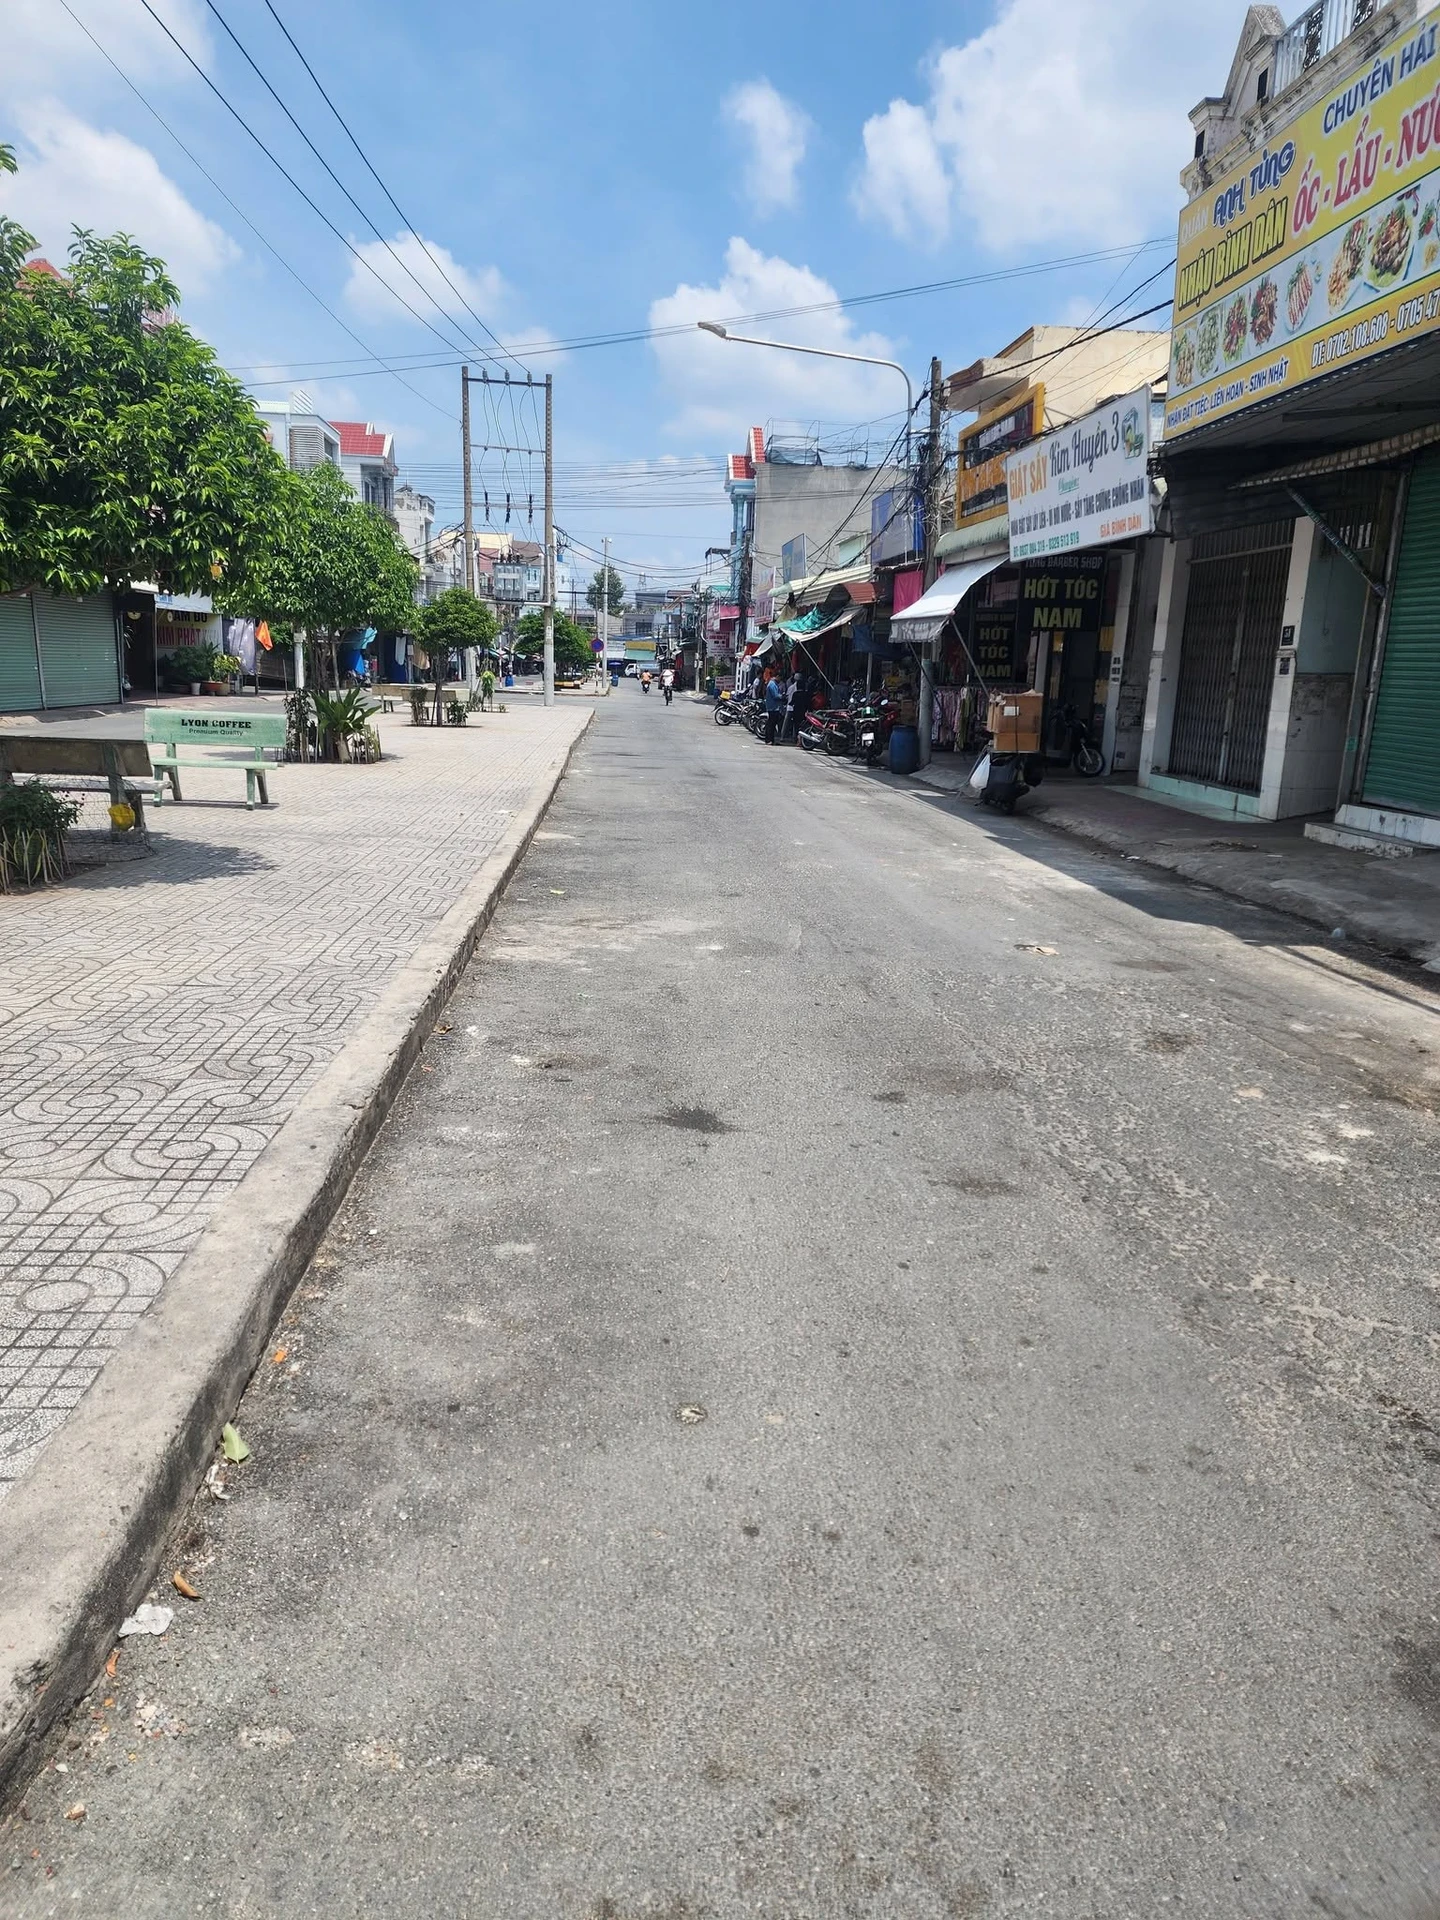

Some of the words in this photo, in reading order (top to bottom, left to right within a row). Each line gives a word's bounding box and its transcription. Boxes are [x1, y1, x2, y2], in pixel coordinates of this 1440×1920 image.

[1323, 55, 1395, 134] CHUYÊN
[1400, 22, 1439, 79] HẢI
[1294, 157, 1320, 233] ỐC
[1324, 189, 1330, 203] -
[1334, 114, 1382, 208] LẨU
[1384, 148, 1392, 164] -
[1182, 205, 1208, 243] QUÁN
[1178, 248, 1215, 311] NHẬU
[1215, 229, 1252, 288] BÌNH
[1252, 196, 1288, 264] DÂN
[1326, 310, 1389, 363] 0702.108.608
[1396, 294, 1425, 333] 0705
[1166, 404, 1182, 429] NHẬN
[1182, 400, 1195, 424] ĐẶT
[1210, 384, 1225, 410] LIÊN
[1225, 379, 1244, 402] HOAN
[1249, 371, 1267, 393] SINH
[1267, 357, 1289, 387] NHẬT
[1009, 460, 1027, 504] GIẶT
[1030, 441, 1047, 493] SẤY
[1050, 440, 1070, 477] Kim
[1072, 421, 1109, 473] Huyền
[1111, 411, 1119, 451] 3
[1101, 521, 1110, 538] GIÁ
[1080, 556, 1103, 570] SHOP
[1024, 575, 1060, 599] HỚT
[1064, 576, 1099, 600] TÓC
[1033, 607, 1083, 629] NAM
[979, 625, 1010, 641] HỚT
[978, 644, 1009, 659] TÓC
[975, 664, 1011, 677] NAM
[181, 719, 209, 728] LYON
[212, 720, 252, 729] COFFEE
[220, 729, 243, 737] Quality
